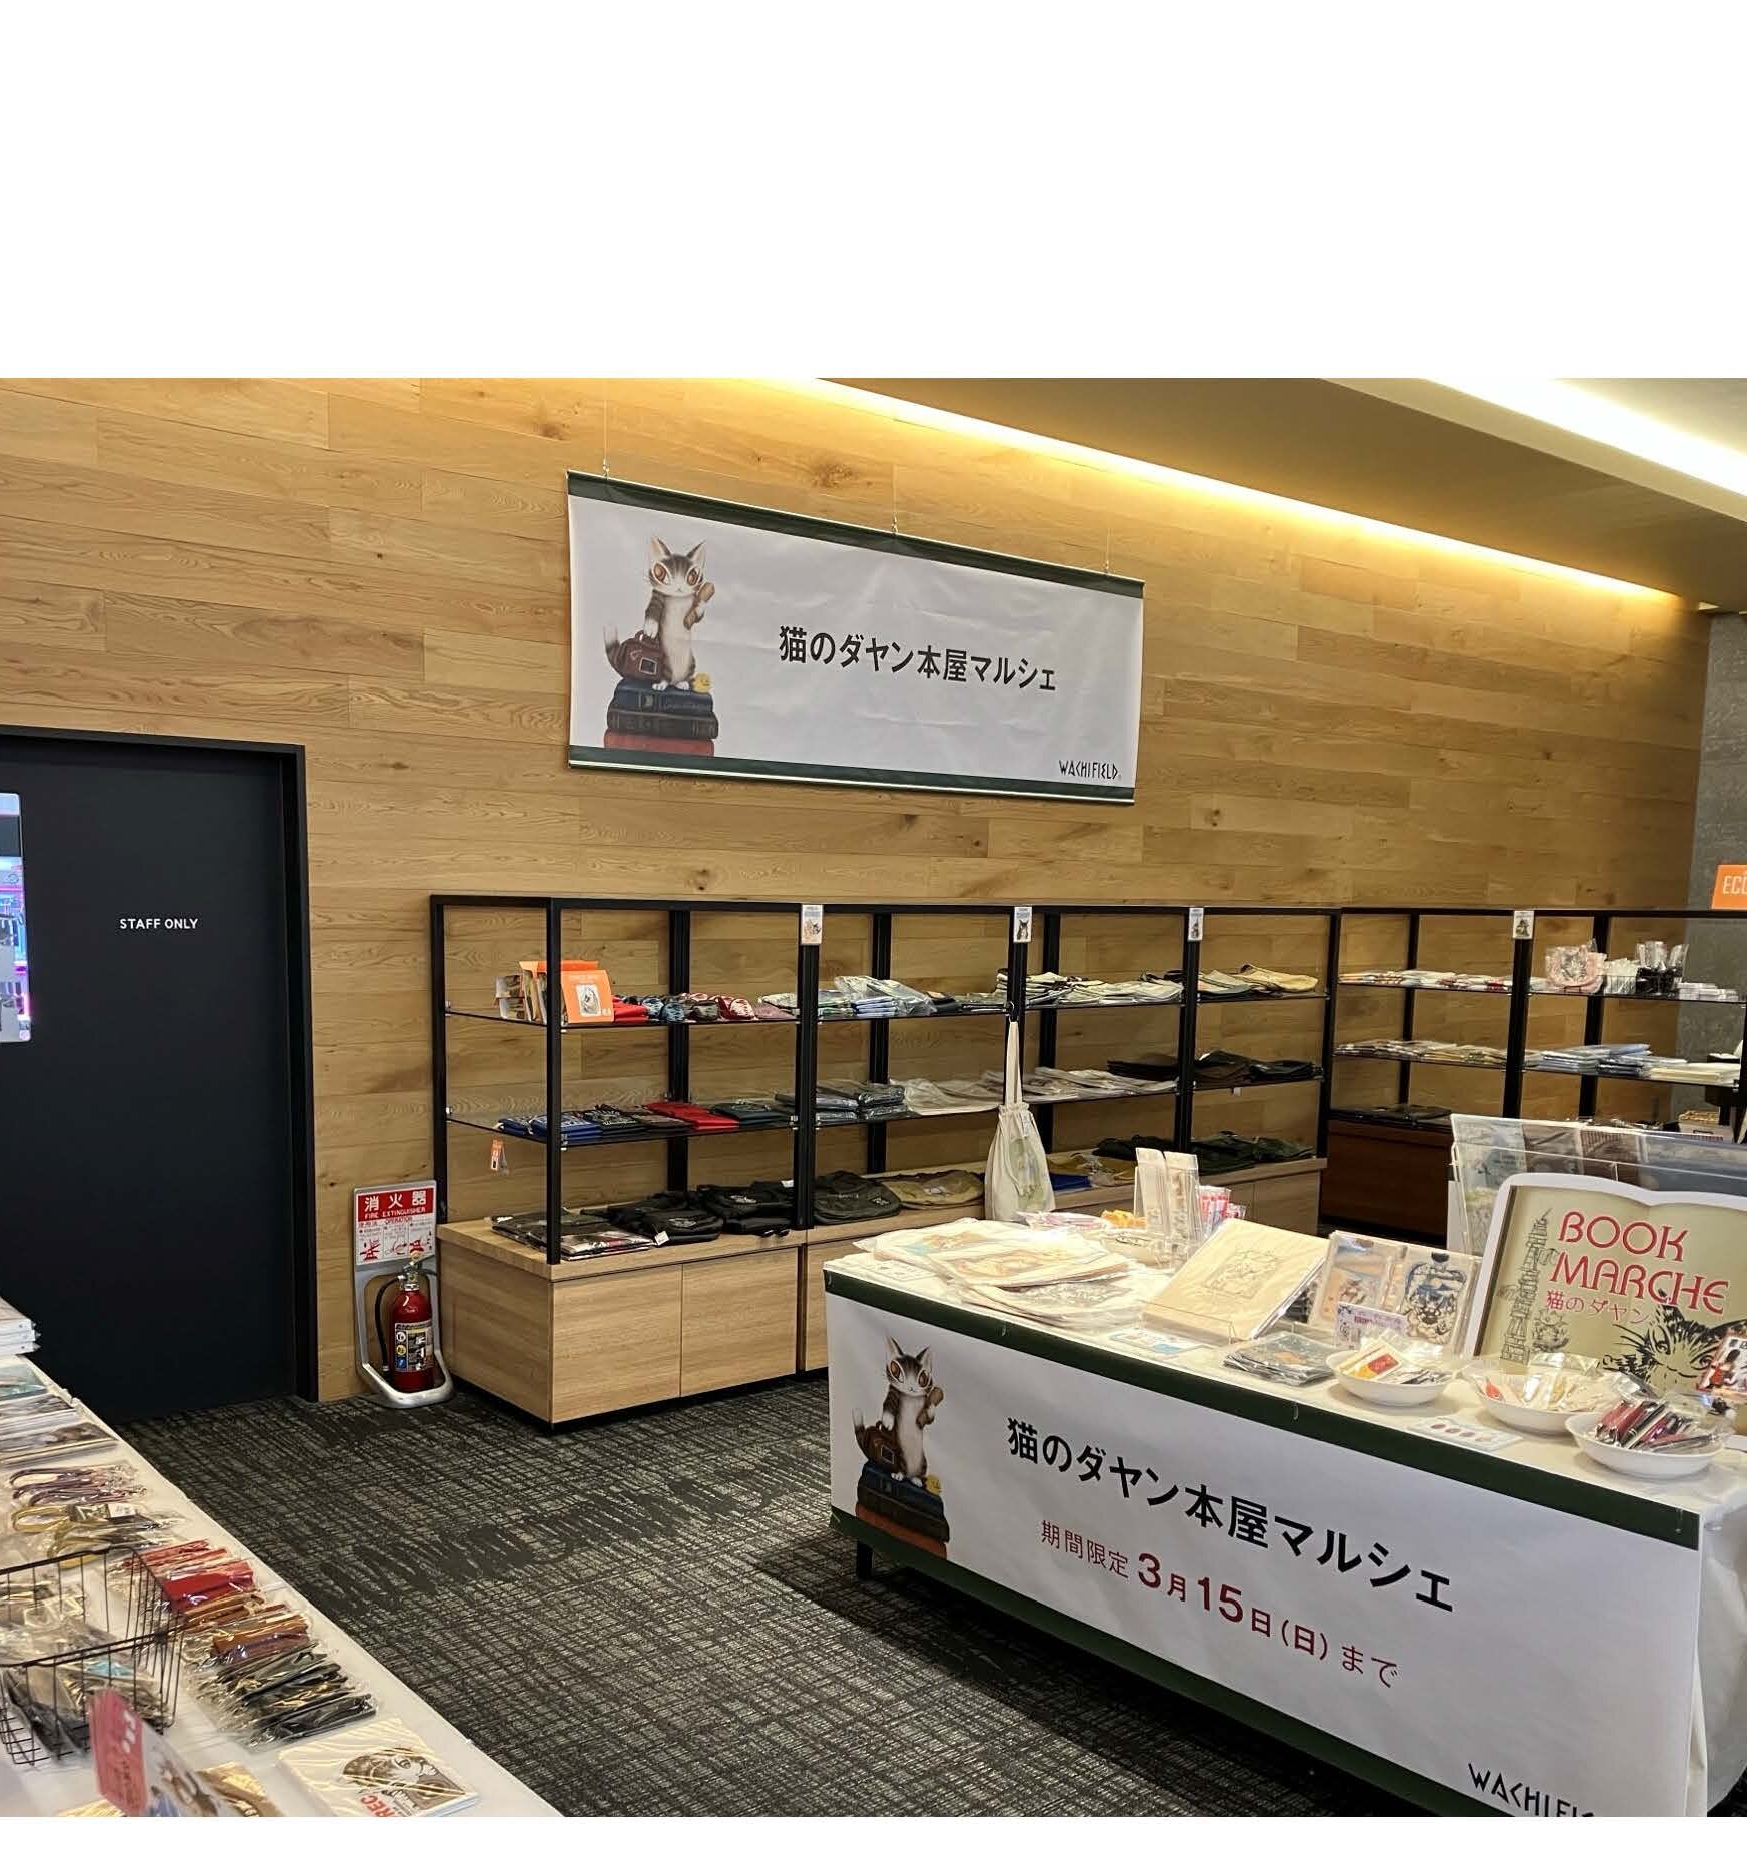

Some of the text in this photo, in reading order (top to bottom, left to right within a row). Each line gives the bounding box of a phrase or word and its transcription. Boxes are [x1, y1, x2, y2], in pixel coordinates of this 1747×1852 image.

[779, 625, 1057, 692] 猫のダヤン本屋マルシェ
[119, 917, 199, 931] STAFF ONLY
[364, 1190, 427, 1212] 消火器
[1558, 1211, 1688, 1262] BOOK
[1547, 1289, 1650, 1324] 猫のダヤン
[1549, 1251, 1729, 1315] MARCHE
[1007, 1416, 1455, 1614] 猫のダヤン本屋マルシェ
